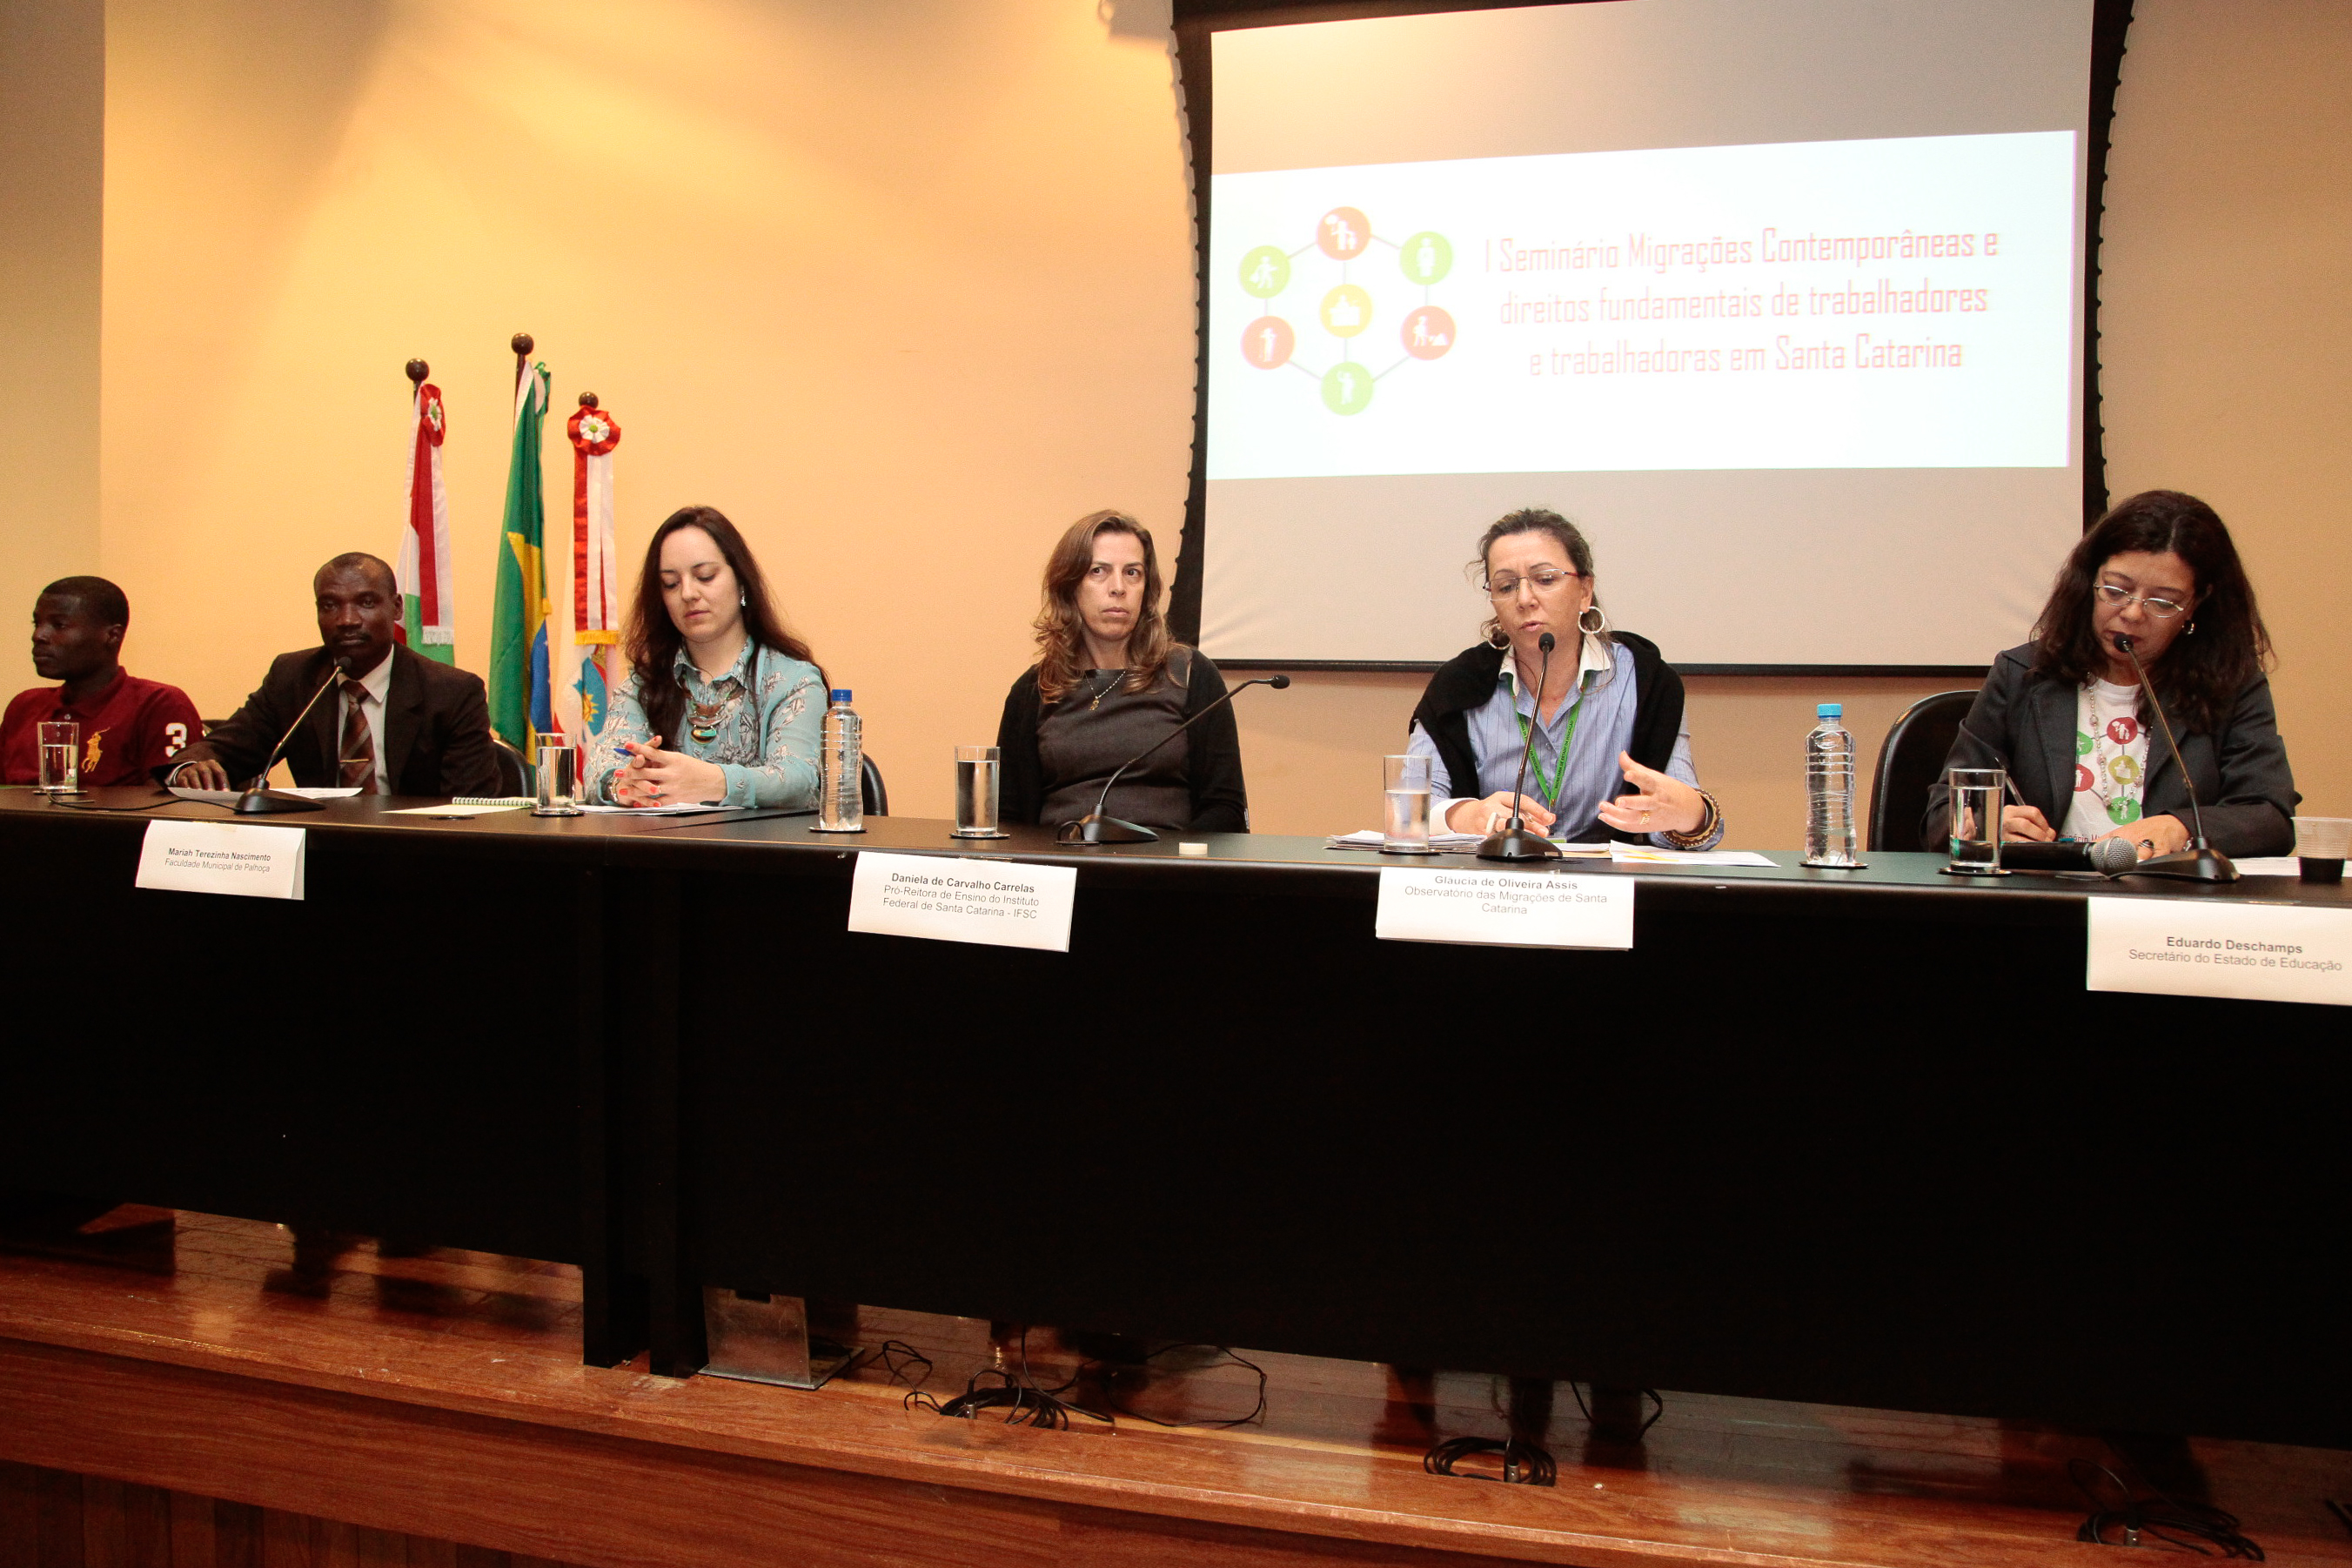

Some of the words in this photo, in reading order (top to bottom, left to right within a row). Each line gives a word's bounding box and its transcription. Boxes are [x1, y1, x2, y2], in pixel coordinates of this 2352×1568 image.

[1484, 238, 1490, 272] I
[1499, 238, 1618, 272] Seminário
[1628, 231, 1752, 274] Migrações
[1762, 227, 1975, 268] Contemporâneas
[1983, 232, 1999, 256] e
[1500, 291, 1590, 325] direitos
[1599, 285, 1762, 321] fundamentais
[1772, 281, 1799, 316] de
[1809, 277, 1988, 316] trabalhadores
[1530, 353, 1542, 376] e
[1551, 338, 1721, 376] trabalhadoras
[1730, 348, 1766, 372] em
[1775, 334, 1846, 371] Santa
[1855, 332, 1962, 369] Catarina
[165, 722, 187, 757] 3
[168, 848, 193, 857] Mariah
[195, 849, 230, 860] Terezinha
[231, 852, 271, 861] Nascimento
[164, 857, 200, 868] Faculdade
[202, 861, 233, 871] Municipal
[244, 864, 271, 874] Palhoça
[891, 873, 928, 885] Daniela
[931, 875, 943, 887] de
[947, 877, 991, 890] Carvalho
[994, 881, 1035, 894] Carrelas
[1435, 874, 1478, 886] Gláucia
[1481, 877, 1495, 887] de
[1498, 878, 1543, 889] Oliveira
[1545, 880, 1578, 889] Assis
[883, 885, 937, 898] Pró-Reitora
[940, 889, 952, 900] de
[955, 891, 987, 902] Ensino
[988, 894, 1001, 904] do
[1003, 895, 1040, 907] Instituto
[1404, 886, 1473, 899] Observatório
[1477, 890, 1496, 900] das
[1499, 891, 1555, 904] Migrações
[1558, 893, 1571, 902] de
[1575, 894, 1607, 903] Santa
[882, 897, 918, 909] Federal
[921, 901, 933, 911] de
[935, 901, 963, 914] Santa
[966, 905, 1005, 917] Catarina
[1013, 909, 1037, 919] IFSC
[1481, 902, 1527, 915] Catarina
[2167, 936, 2221, 949] Eduardo
[2226, 939, 2303, 955] Deschamps
[2128, 949, 2191, 962] Secretário
[2195, 953, 2210, 963] do
[2215, 954, 2256, 967] Estado
[2260, 956, 2276, 968] de
[2280, 957, 2342, 972] Educação
